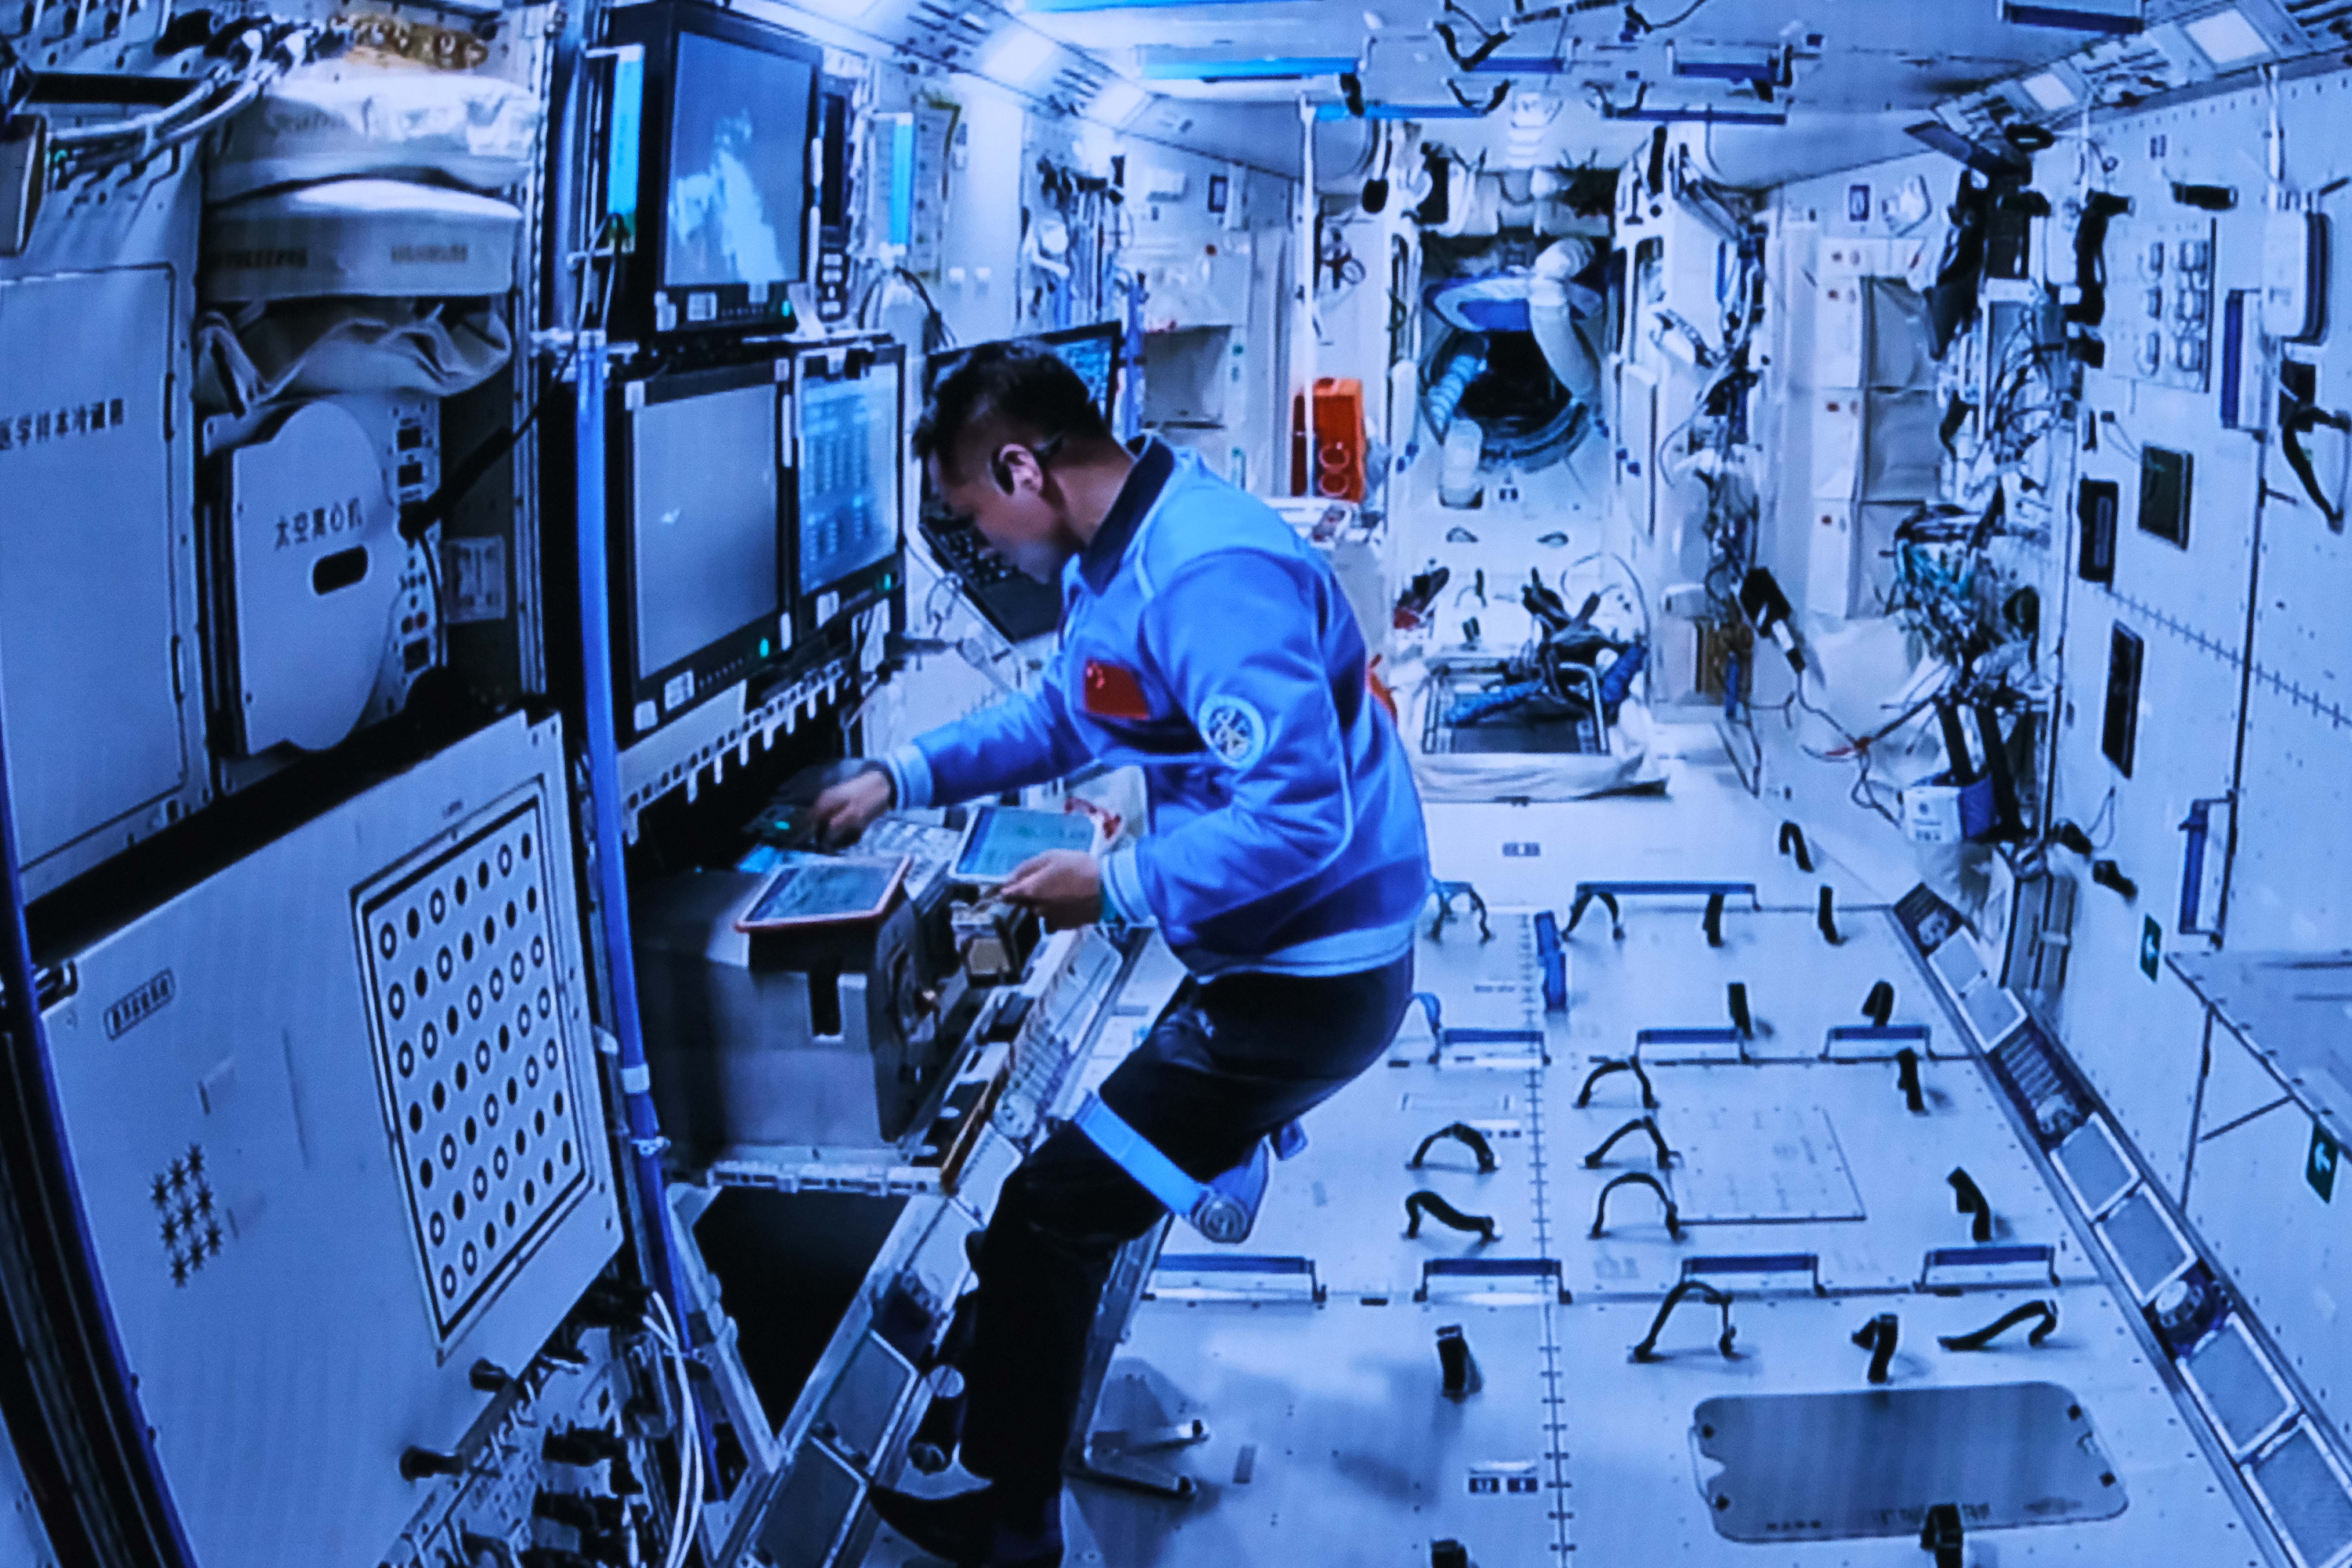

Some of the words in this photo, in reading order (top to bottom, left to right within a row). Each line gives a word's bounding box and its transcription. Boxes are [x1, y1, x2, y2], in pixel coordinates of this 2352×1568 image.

[275, 497, 363, 550] 太空离心机
